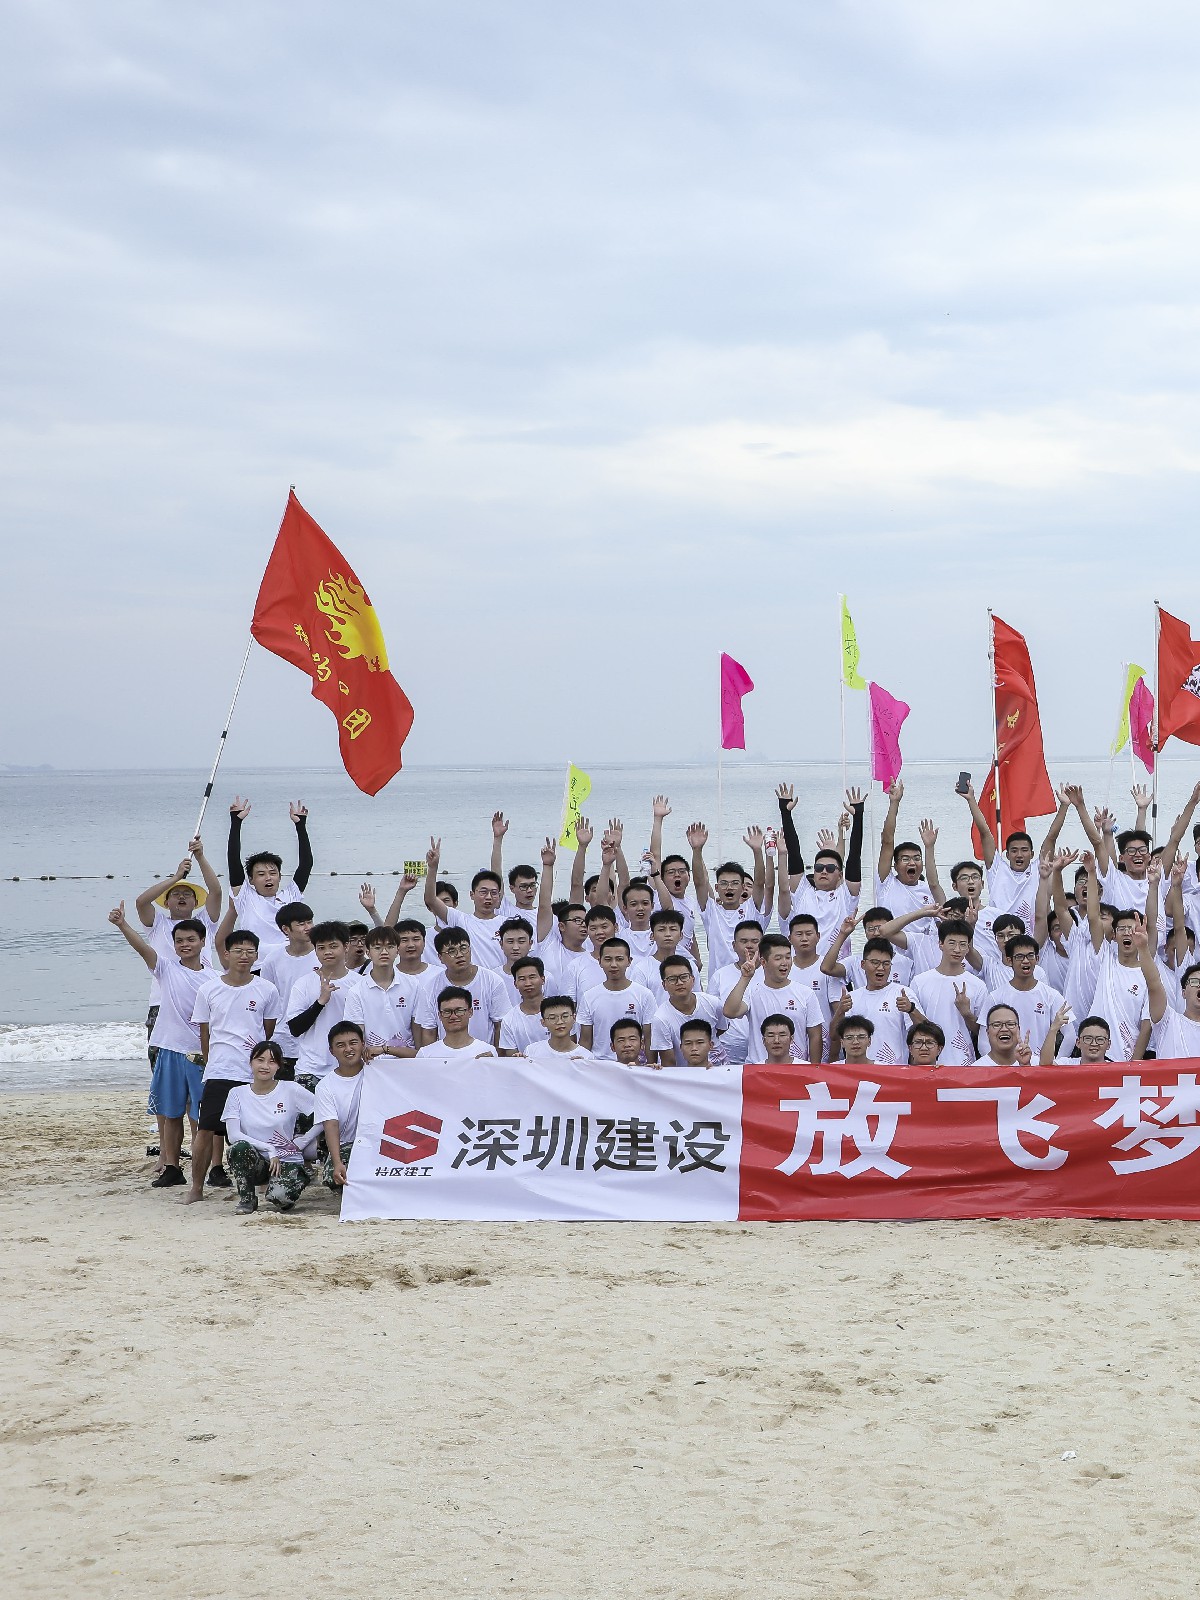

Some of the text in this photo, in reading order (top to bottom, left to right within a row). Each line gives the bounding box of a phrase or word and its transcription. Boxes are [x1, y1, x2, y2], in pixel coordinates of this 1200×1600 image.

[451, 1115, 731, 1174] 深圳建设
[375, 1166, 434, 1177] 特区建工
